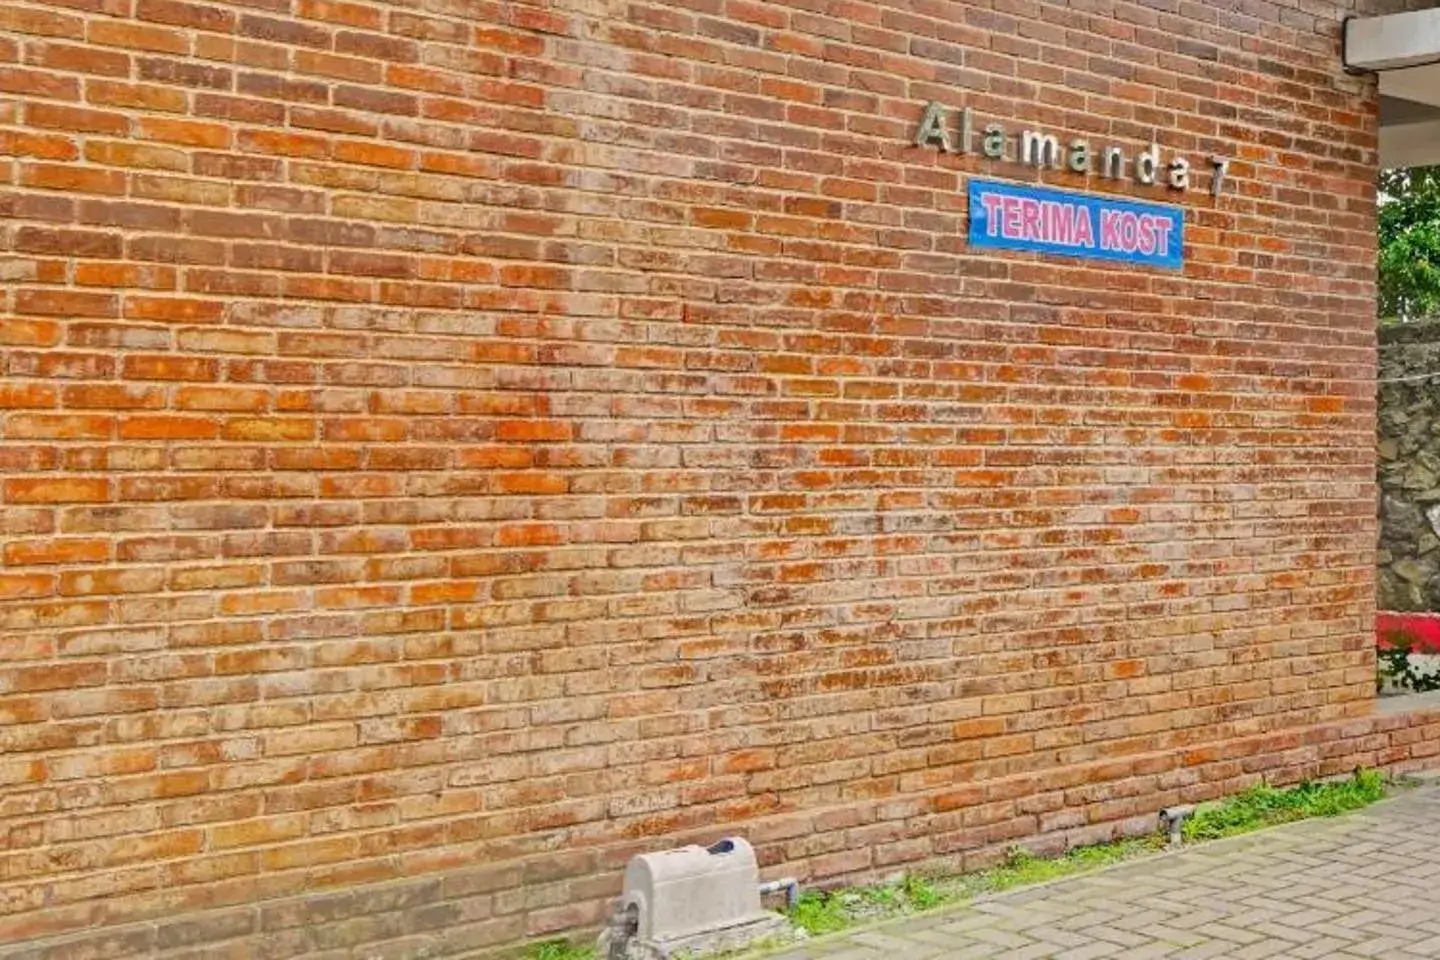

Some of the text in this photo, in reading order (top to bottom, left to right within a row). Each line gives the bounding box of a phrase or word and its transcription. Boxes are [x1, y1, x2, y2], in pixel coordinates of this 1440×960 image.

[912, 101, 1229, 196] Alamanda 7
[980, 192, 1174, 257] TERIMA KOST
